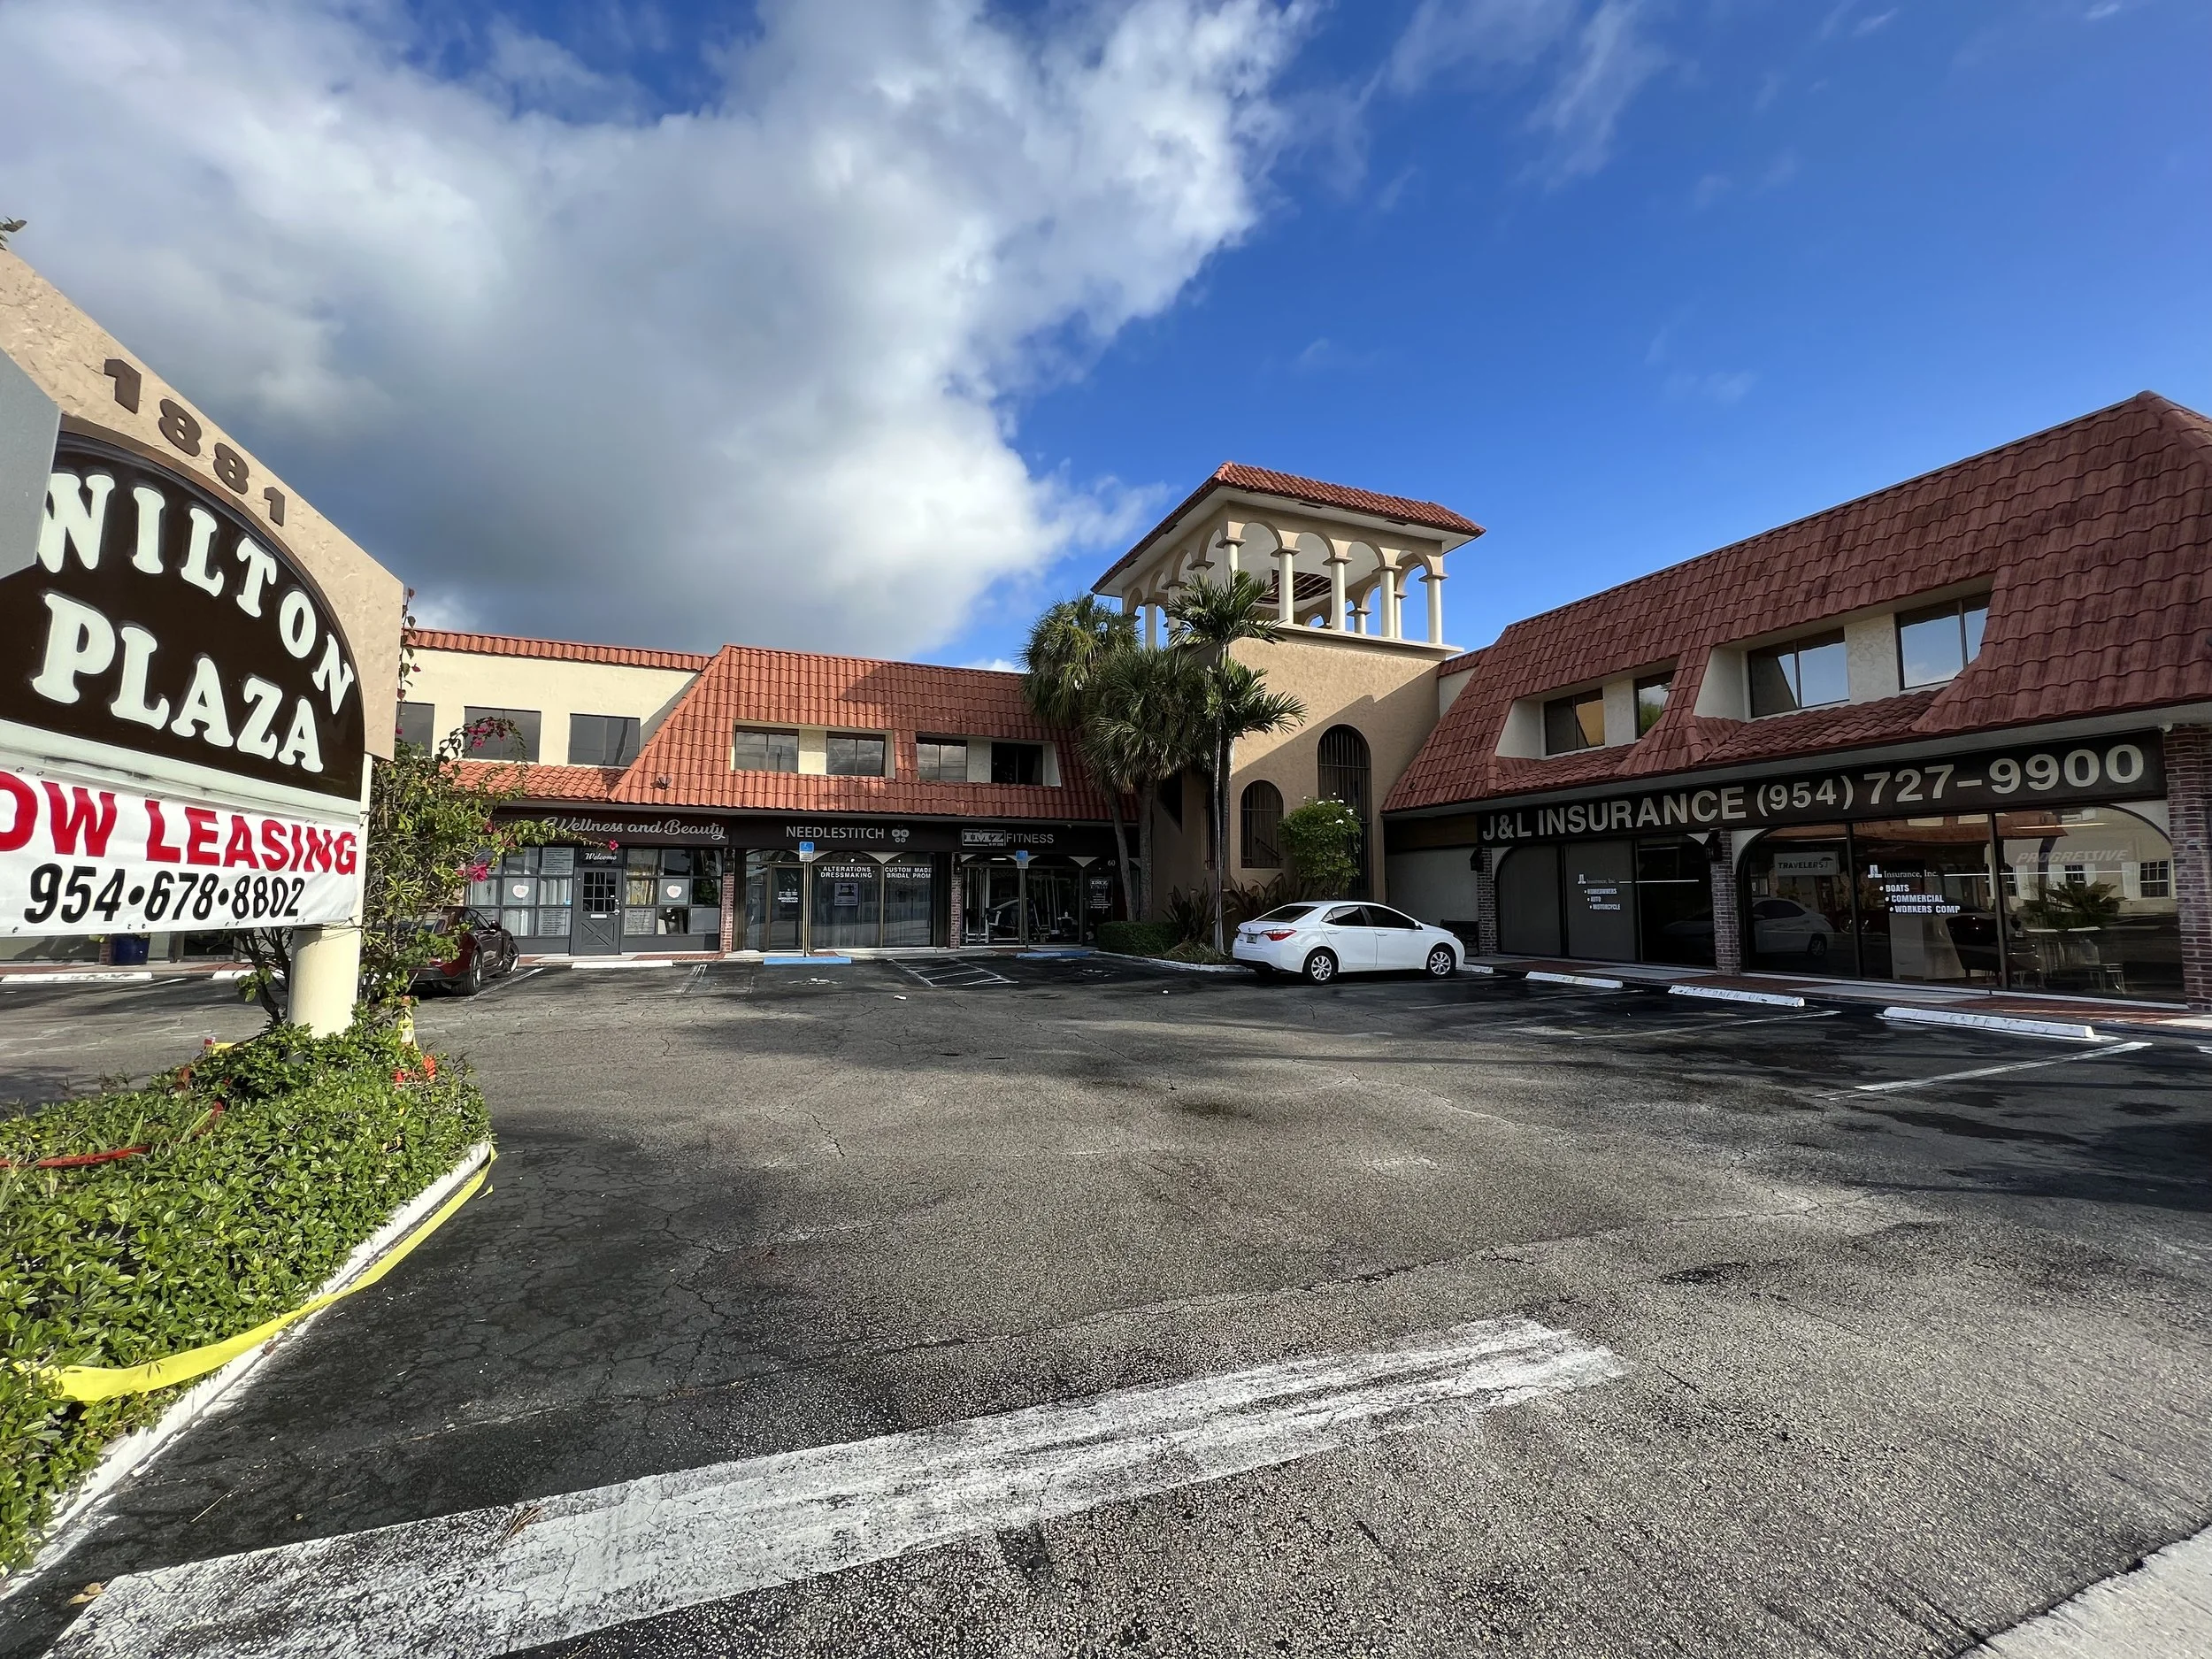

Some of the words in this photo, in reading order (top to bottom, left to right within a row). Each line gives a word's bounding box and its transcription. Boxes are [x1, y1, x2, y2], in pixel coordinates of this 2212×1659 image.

[104, 358, 286, 527] 1881
[37, 472, 354, 714] WILTON
[32, 593, 324, 772] PLAZA
[0, 771, 117, 857] OW
[145, 800, 357, 875] LEASING
[544, 817, 623, 833] Wellness
[627, 820, 662, 833] and
[664, 819, 726, 840] Beauty
[786, 826, 885, 839] NEEDLESTITCH
[964, 833, 1004, 842] IMZ
[1006, 833, 1054, 843] FITNESS
[1483, 812, 1532, 841] J&L
[1538, 787, 1747, 836] INSURANCE
[1756, 775, 1855, 817] (954)
[1863, 743, 2144, 805] 727-9900
[2016, 850, 2128, 863] PROGRESSIVE
